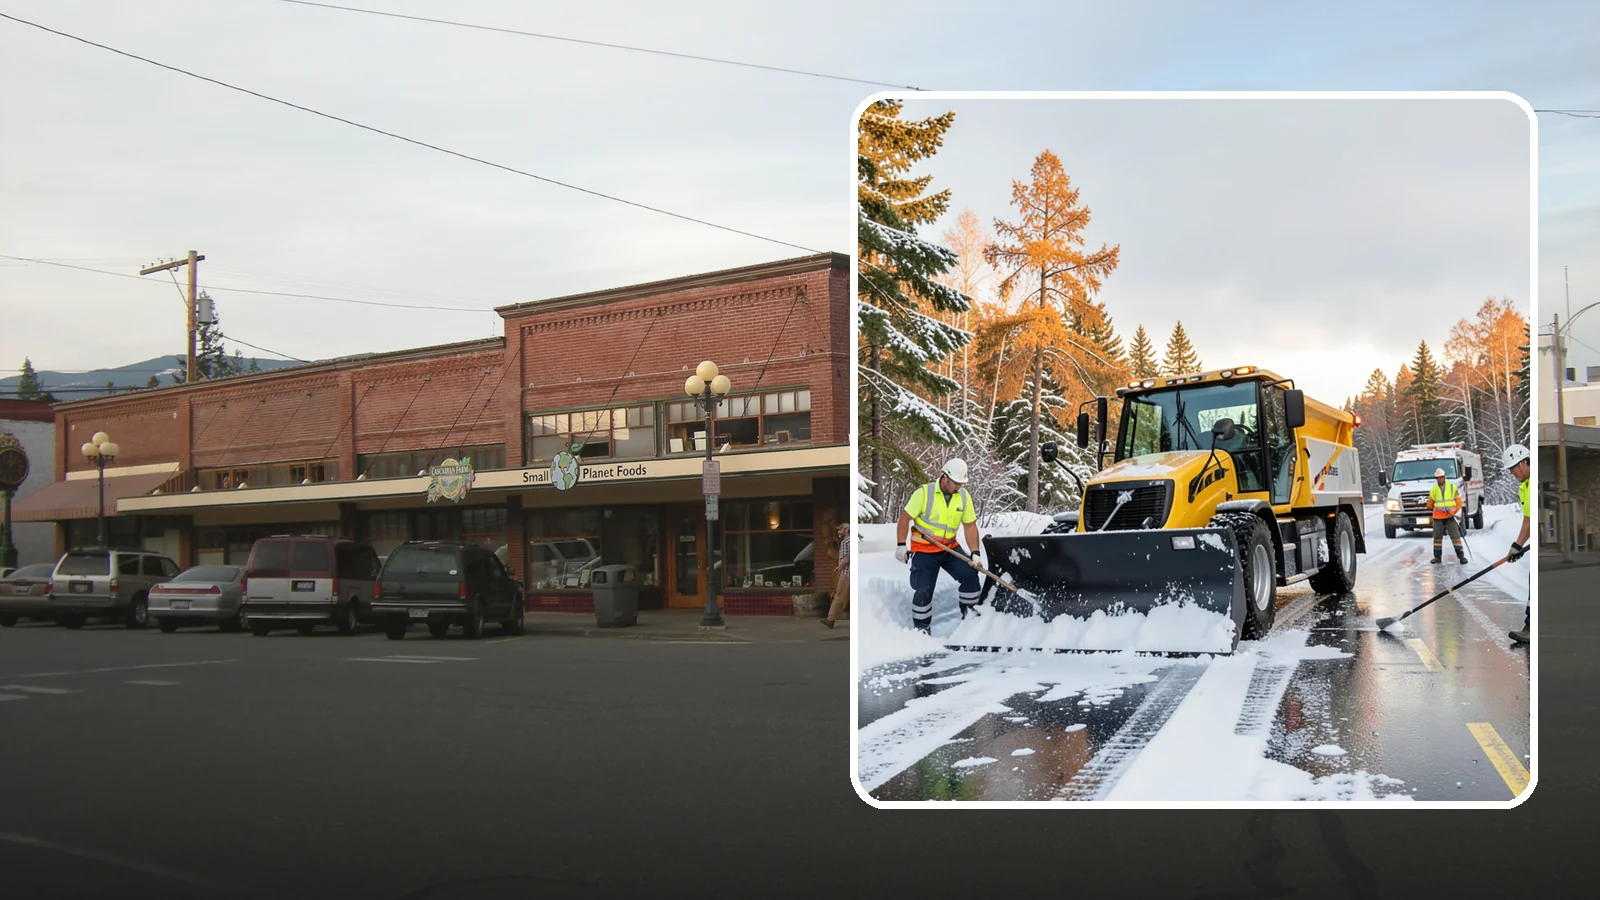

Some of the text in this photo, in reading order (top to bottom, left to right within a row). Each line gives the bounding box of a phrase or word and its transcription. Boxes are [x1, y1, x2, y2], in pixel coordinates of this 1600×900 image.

[456, 466, 469, 474] FARM
[523, 464, 647, 483] Small Planet Foods
